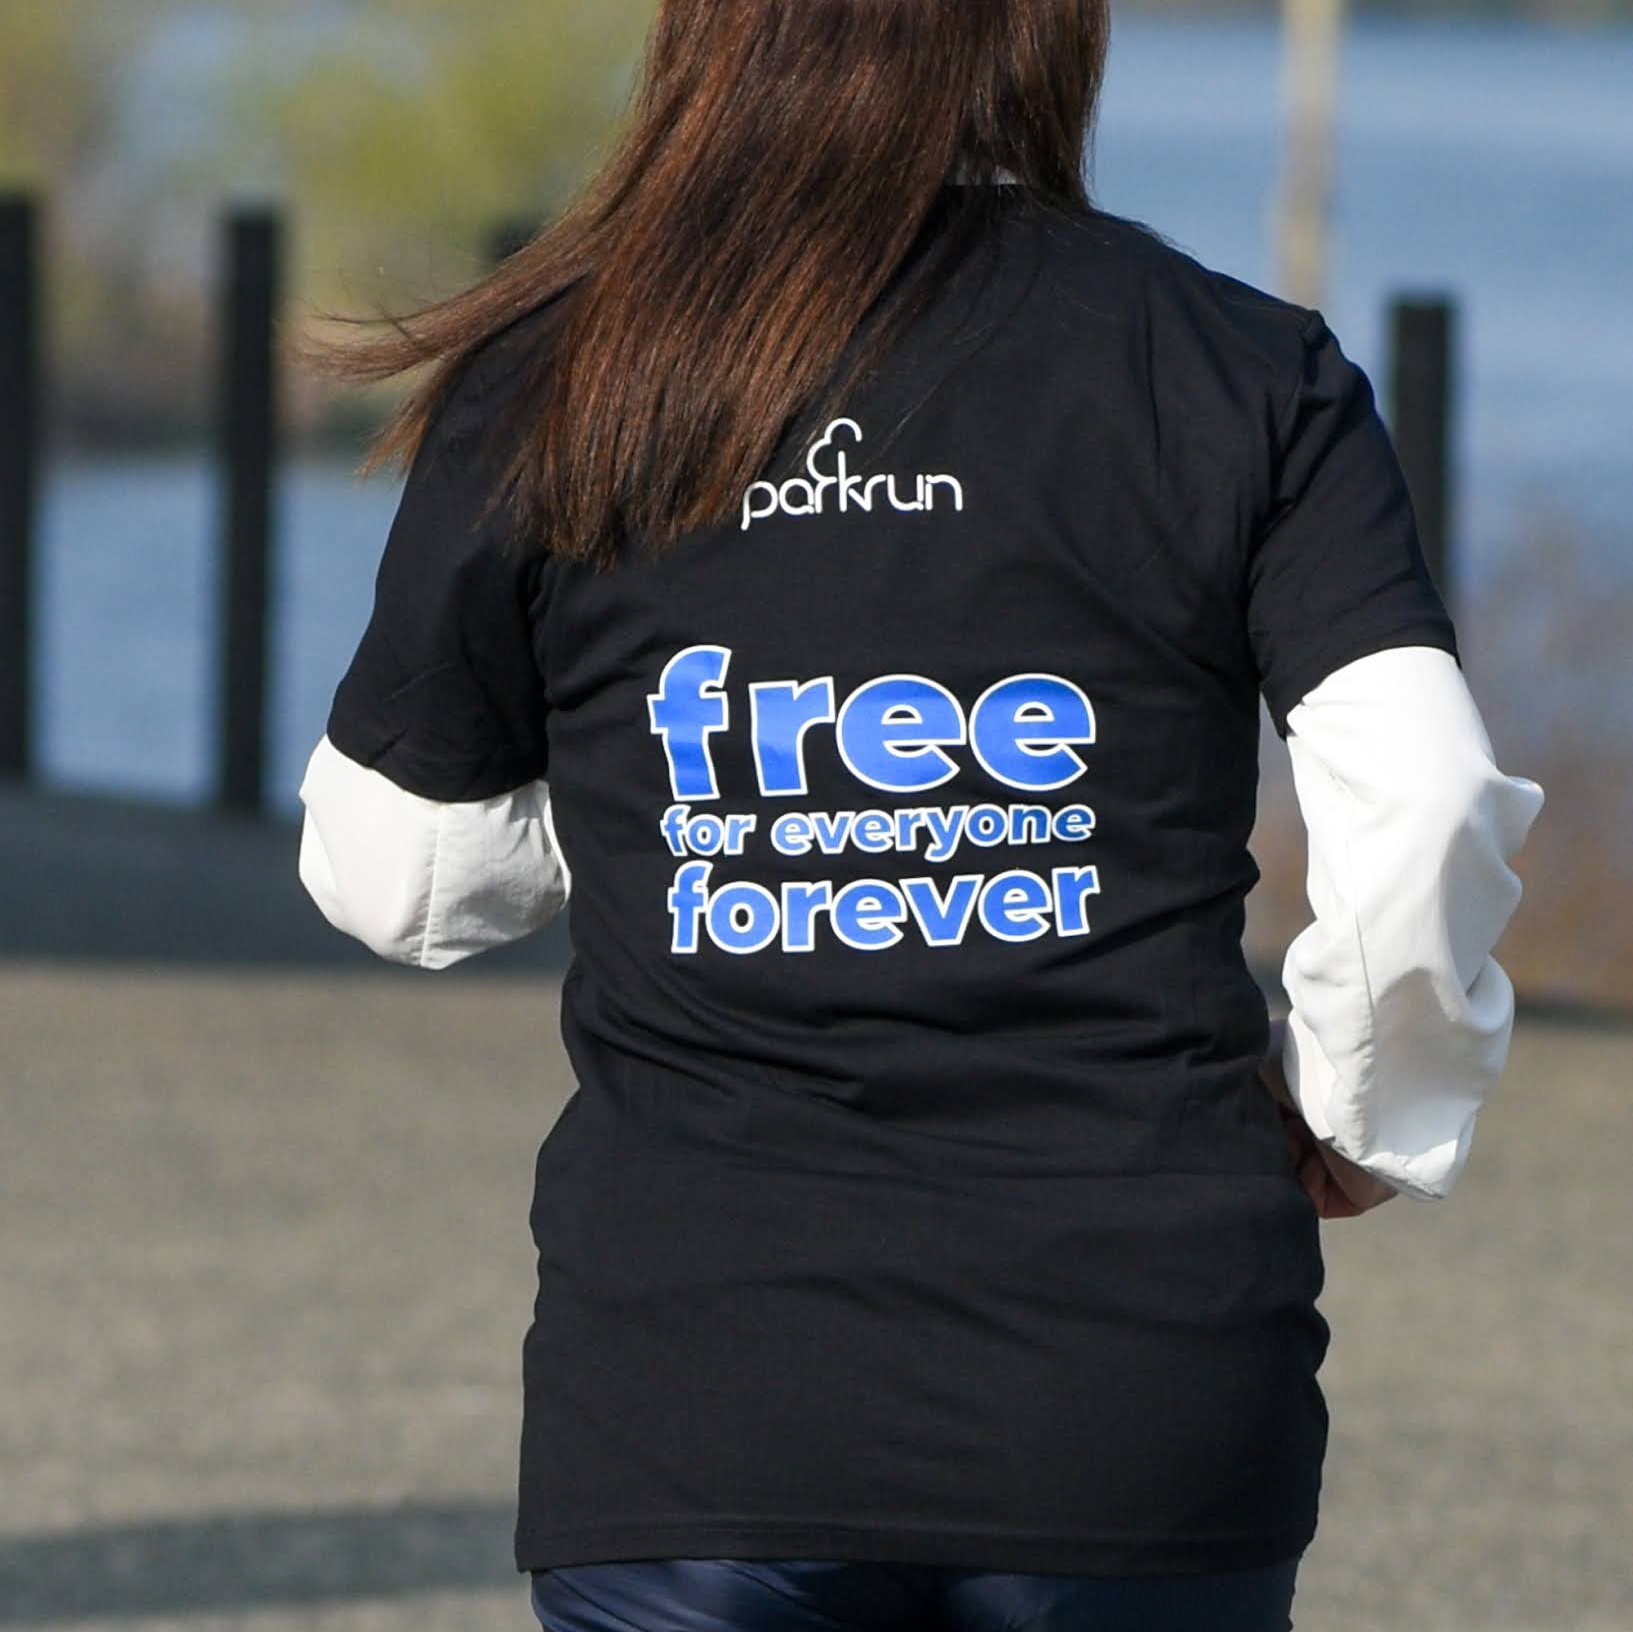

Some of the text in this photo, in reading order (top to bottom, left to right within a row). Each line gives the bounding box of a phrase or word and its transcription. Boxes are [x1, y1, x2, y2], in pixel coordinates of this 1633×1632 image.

[741, 447, 964, 531] parkrun
[646, 643, 1097, 802] free
[659, 803, 1097, 863] for everyone
[667, 859, 1102, 955] forever
